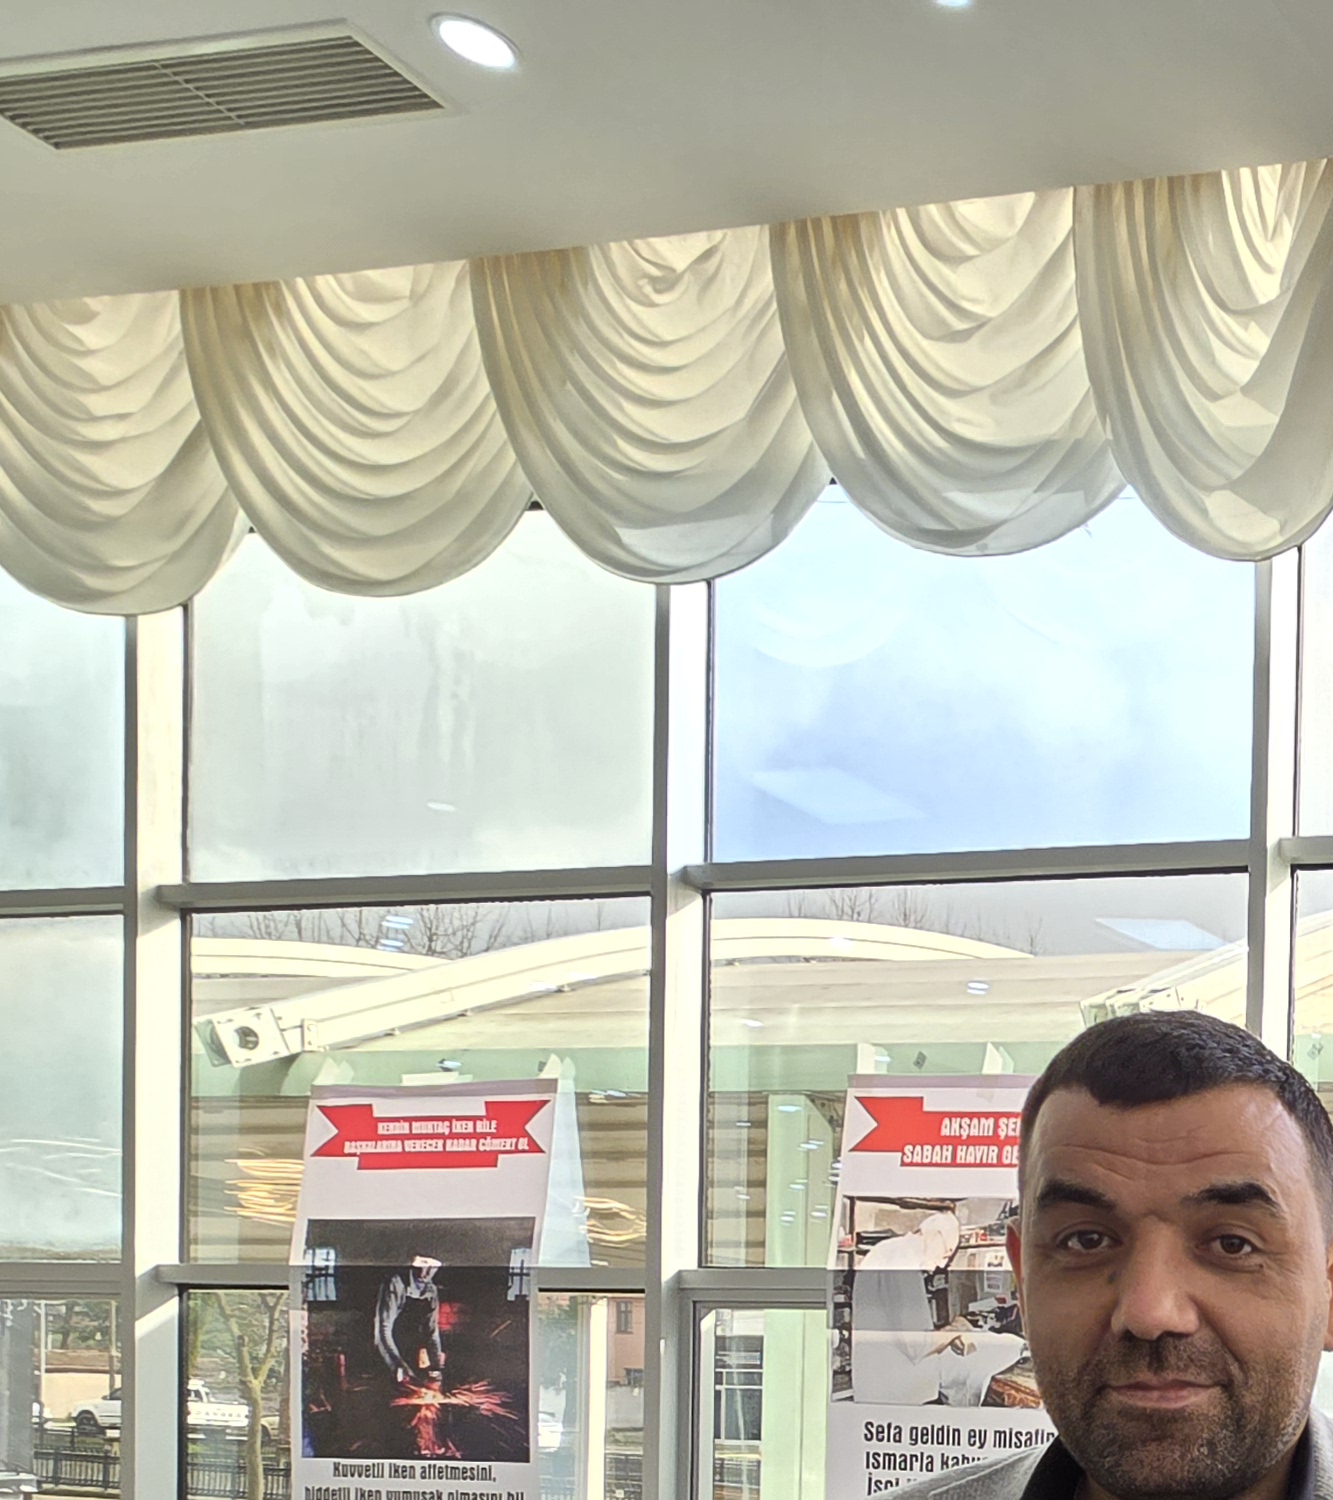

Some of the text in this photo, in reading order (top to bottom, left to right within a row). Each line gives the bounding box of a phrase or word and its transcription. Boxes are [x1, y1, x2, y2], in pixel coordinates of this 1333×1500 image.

[903, 1144, 952, 1164] SABAH
[956, 1145, 998, 1164] HAYIR
[864, 1421, 902, 1443] Sefa
[909, 1424, 961, 1446] geldin
[967, 1428, 988, 1449] ey
